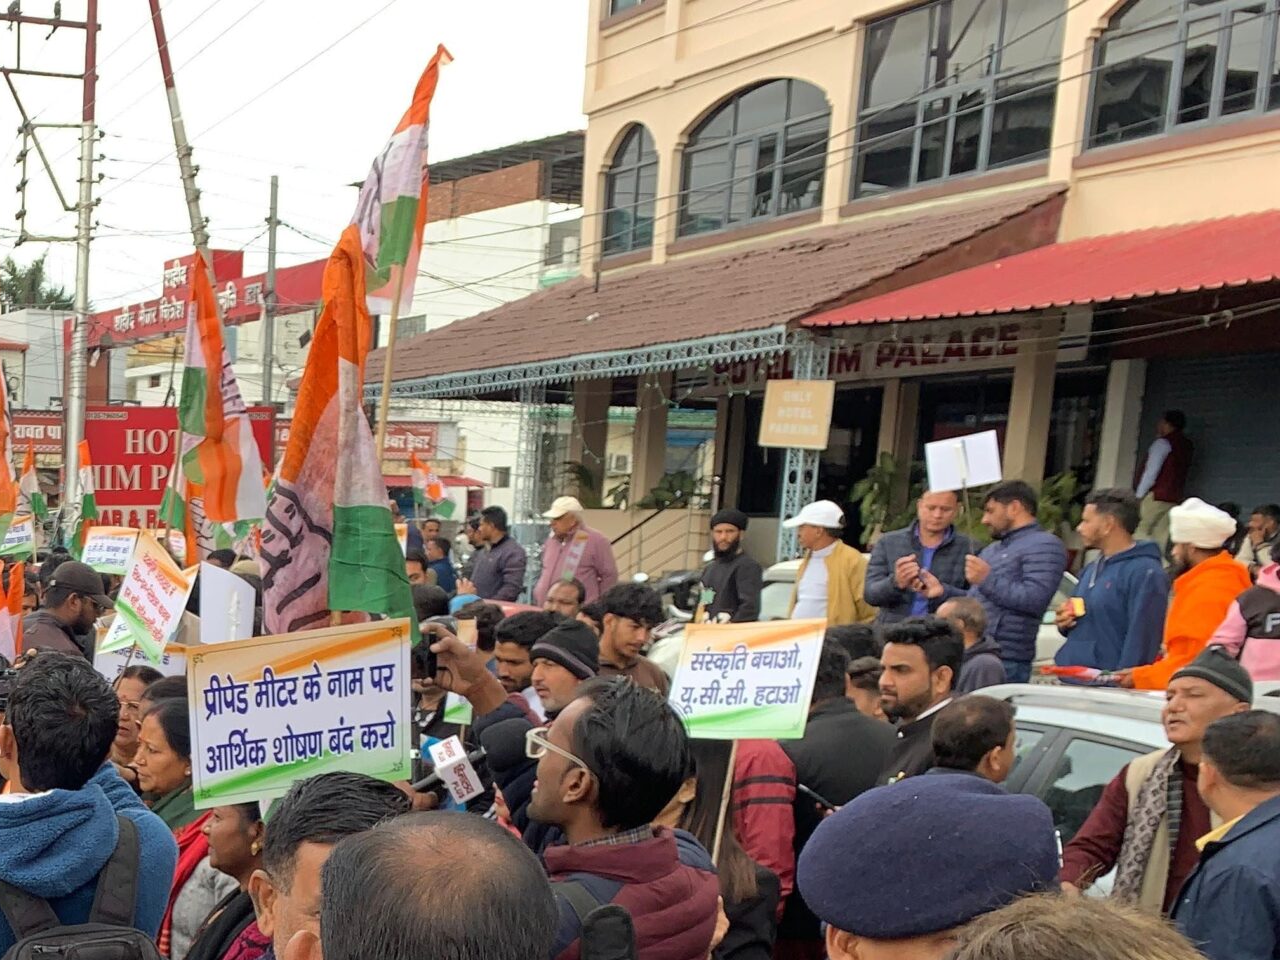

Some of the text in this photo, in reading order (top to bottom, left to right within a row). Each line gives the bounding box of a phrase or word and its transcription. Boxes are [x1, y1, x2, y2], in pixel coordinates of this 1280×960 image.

[875, 323, 1020, 369] PALACE
[125, 428, 181, 455] HOT
[690, 642, 803, 679] संस्कृति बचाओ,
[203, 662, 396, 721] प्रीपेड मीटर के नाम पर
[680, 677, 802, 715] यू.सी.सी. हटाओ
[206, 709, 396, 774] आर्थिक शोषण बंद करो
